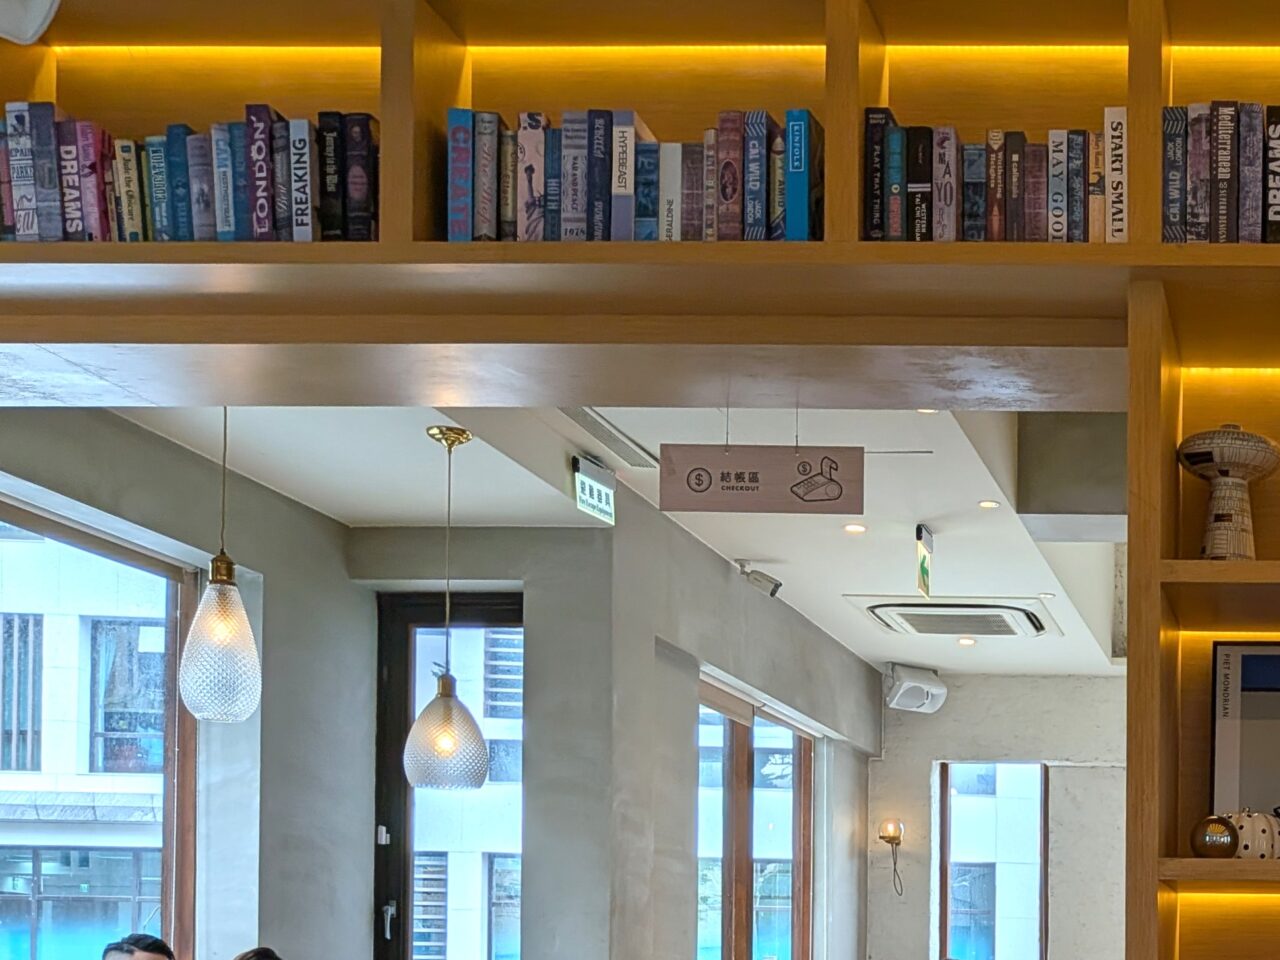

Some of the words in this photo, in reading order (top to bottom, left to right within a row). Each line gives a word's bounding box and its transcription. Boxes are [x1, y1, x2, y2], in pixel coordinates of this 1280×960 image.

[324, 131, 337, 157] Journey
[618, 130, 628, 191] HYPEBEAST
[1052, 141, 1063, 181] MAY
[1111, 121, 1123, 175] START
[1218, 107, 1234, 179] Mediterranean
[60, 146, 82, 232] DREAMS
[151, 149, 165, 200] EDUCATION
[295, 138, 308, 228] FREAKING
[451, 126, 471, 234] CREATE
[749, 162, 760, 190] WILD
[1169, 172, 1180, 199] WILD
[1111, 180, 1123, 238] SMALL
[1223, 653, 1231, 672] PIET
[1222, 673, 1231, 718] MONDRIAN
